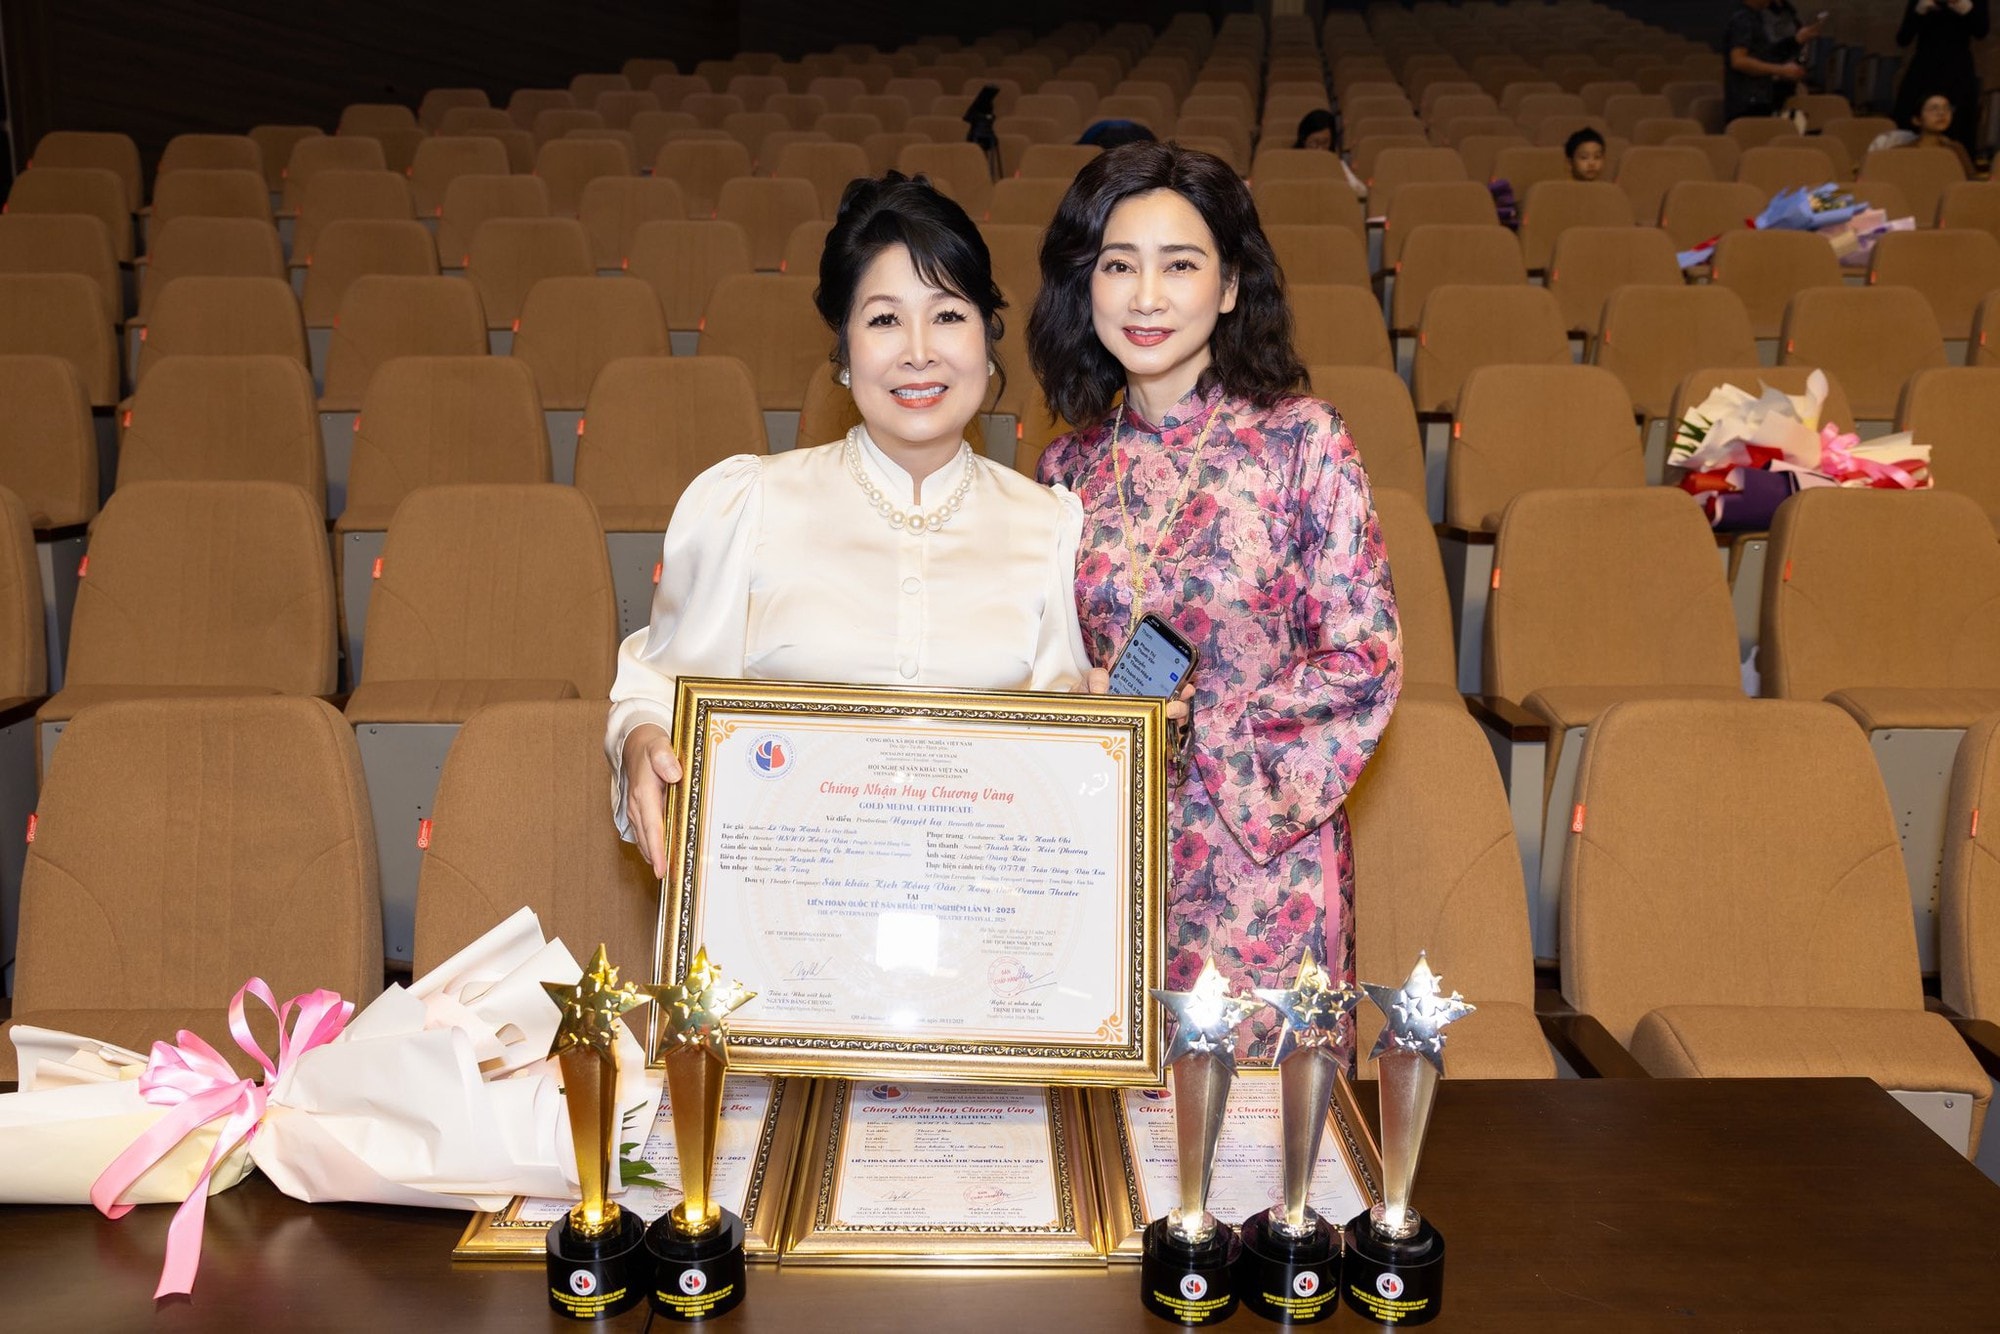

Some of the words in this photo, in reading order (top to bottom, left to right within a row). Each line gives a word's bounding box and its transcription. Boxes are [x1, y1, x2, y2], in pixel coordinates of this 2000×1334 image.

[820, 781, 860, 798] Chứng
[863, 783, 897, 799] Nhận
[902, 785, 927, 800] Huy
[931, 786, 978, 803] Chương
[983, 788, 1015, 805] Vàng
[859, 802, 884, 810] GOLD
[887, 803, 916, 812] MEDAL
[917, 804, 974, 814] CERTIFICATE
[825, 899, 847, 907] HOAN
[730, 1104, 752, 1112] Bạc
[862, 1106, 897, 1114] Chứng
[901, 1106, 931, 1114] Nhận
[935, 1106, 957, 1114] Huy
[961, 1106, 1003, 1114] Chương
[1007, 1106, 1035, 1115] Vàng
[1238, 1106, 1279, 1114] Chương
